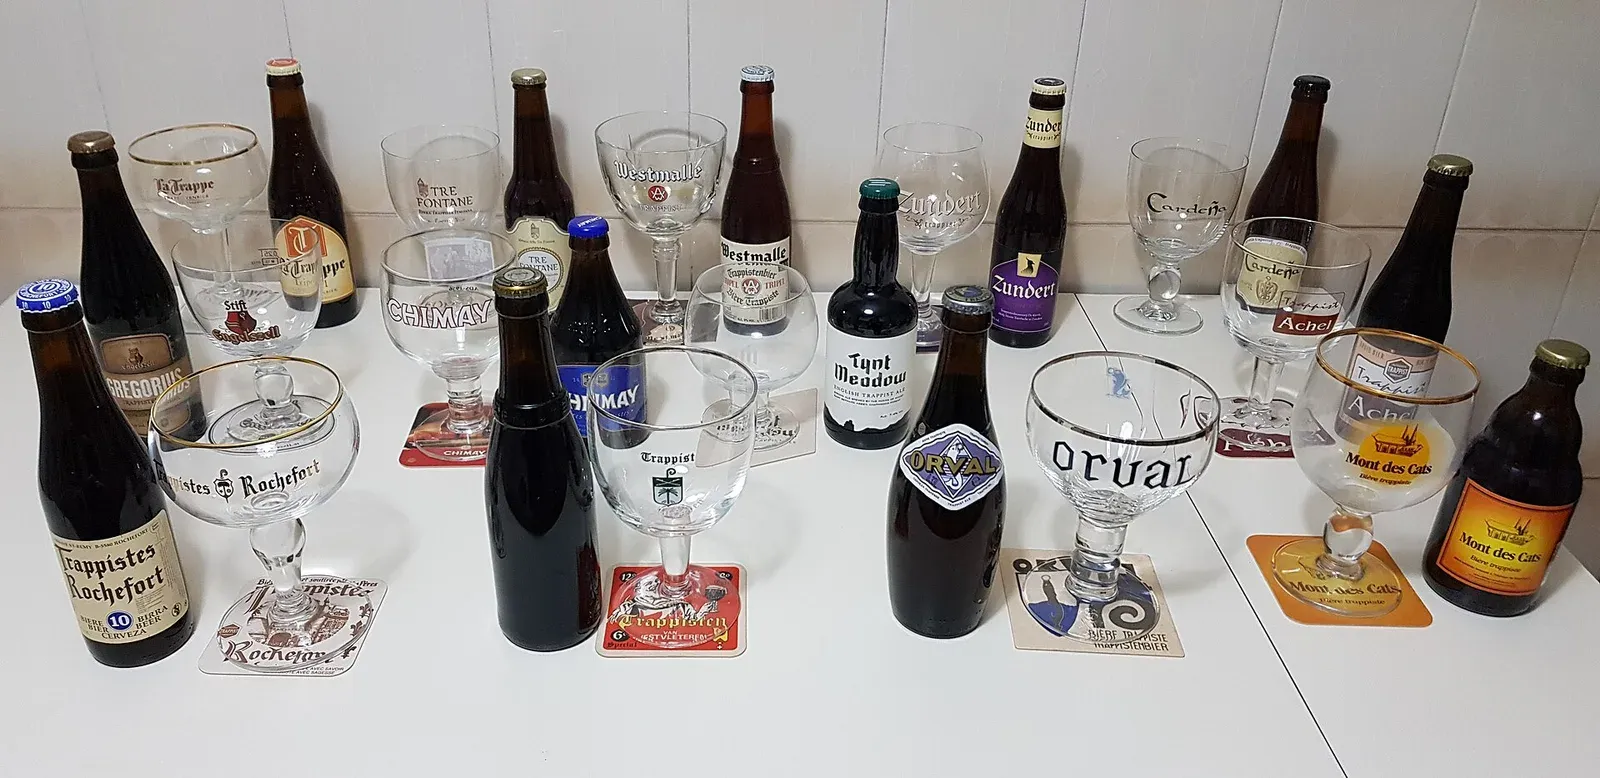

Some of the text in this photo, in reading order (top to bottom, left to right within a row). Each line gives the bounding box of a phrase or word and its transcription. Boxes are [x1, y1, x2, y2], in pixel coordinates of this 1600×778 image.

[1025, 116, 1062, 133] Zunder
[614, 160, 703, 183] Westmalle
[168, 178, 215, 196] Trappe
[430, 186, 458, 197] TRE
[416, 196, 474, 209] FONTANE
[899, 189, 982, 217] Zundert
[1147, 192, 1227, 216] Cardeña
[528, 256, 548, 264] TRE
[721, 242, 787, 263] Westmalle
[1245, 253, 1300, 280] Cardeña
[992, 274, 1056, 299] Zundert
[225, 300, 248, 312] Stift
[387, 298, 494, 329] CHIMAY
[1277, 317, 1333, 332] Achel
[834, 362, 907, 388] Meadow
[848, 352, 891, 375] Tynt
[833, 384, 860, 397] ENGLISH
[861, 391, 895, 399] TRAPPIST
[640, 451, 695, 465] Trappist
[910, 450, 997, 476] ORVAL
[1345, 451, 1433, 476] Mont des Cats
[238, 458, 322, 499] Rochefort
[1459, 531, 1542, 563] Mont des Cats
[54, 543, 157, 580] Trappistes
[64, 565, 165, 607] Rochefort
[1289, 581, 1330, 595] Mont
[1366, 583, 1402, 595] Cats
[109, 614, 131, 628] 10
[136, 604, 169, 623] BIRRA
[135, 615, 162, 630] BEER
[101, 628, 148, 640] CERVEZA
